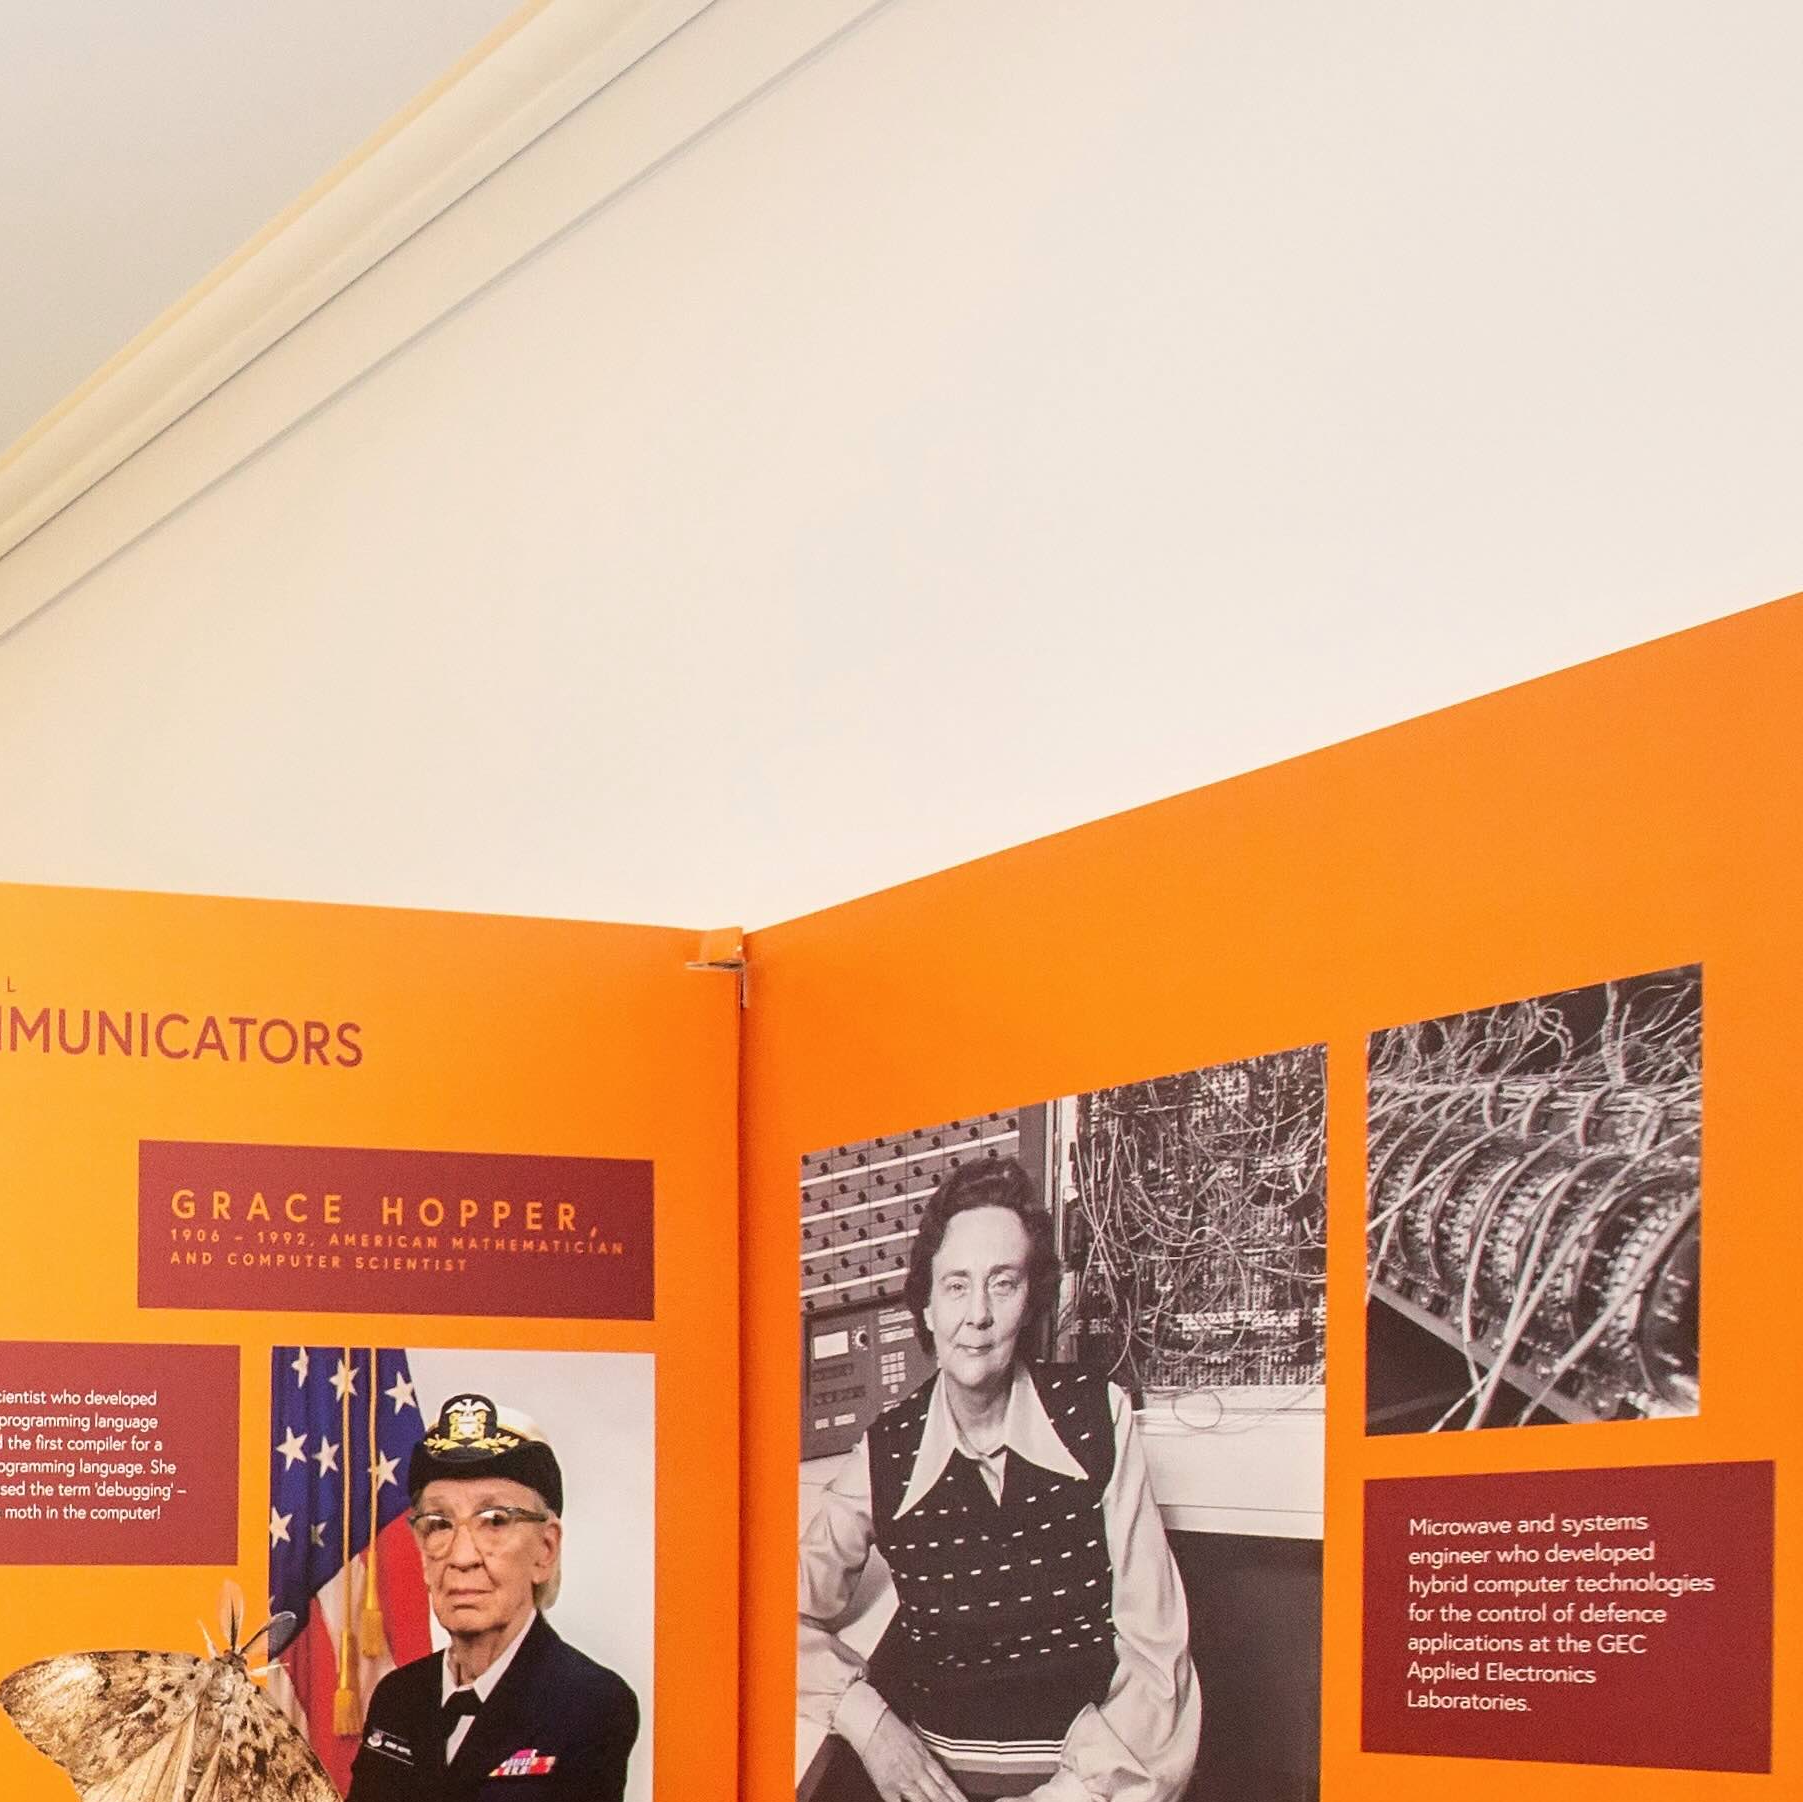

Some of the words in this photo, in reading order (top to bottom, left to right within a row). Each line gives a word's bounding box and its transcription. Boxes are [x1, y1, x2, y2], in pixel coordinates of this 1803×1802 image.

[171, 1188, 342, 1224] GRACE
[382, 1196, 596, 1237] HOPPER,
[170, 1227, 220, 1243] 1906
[257, 1231, 315, 1247] 1992,
[329, 1232, 437, 1249] AMERICAN
[450, 1236, 624, 1255] MATHEMATICIAN
[170, 1251, 213, 1265] AND
[227, 1252, 340, 1269] COMPUTER
[355, 1256, 466, 1271] SCIENTIST
[50, 1389, 81, 1405] who
[84, 1389, 157, 1409] developed
[94, 1412, 158, 1433] language
[4, 1503, 42, 1520] moth
[46, 1505, 59, 1519] in
[62, 1503, 87, 1520] the
[90, 1505, 161, 1523] computer!
[1409, 1518, 1512, 1536] Microwave
[1517, 1513, 1555, 1534] and
[1561, 1514, 1649, 1537] systems
[1409, 1573, 1468, 1599] hybrid
[1473, 1576, 1570, 1598] computer
[1575, 1571, 1715, 1598] technologies
[1407, 1690, 1532, 1712] Laboratories.
